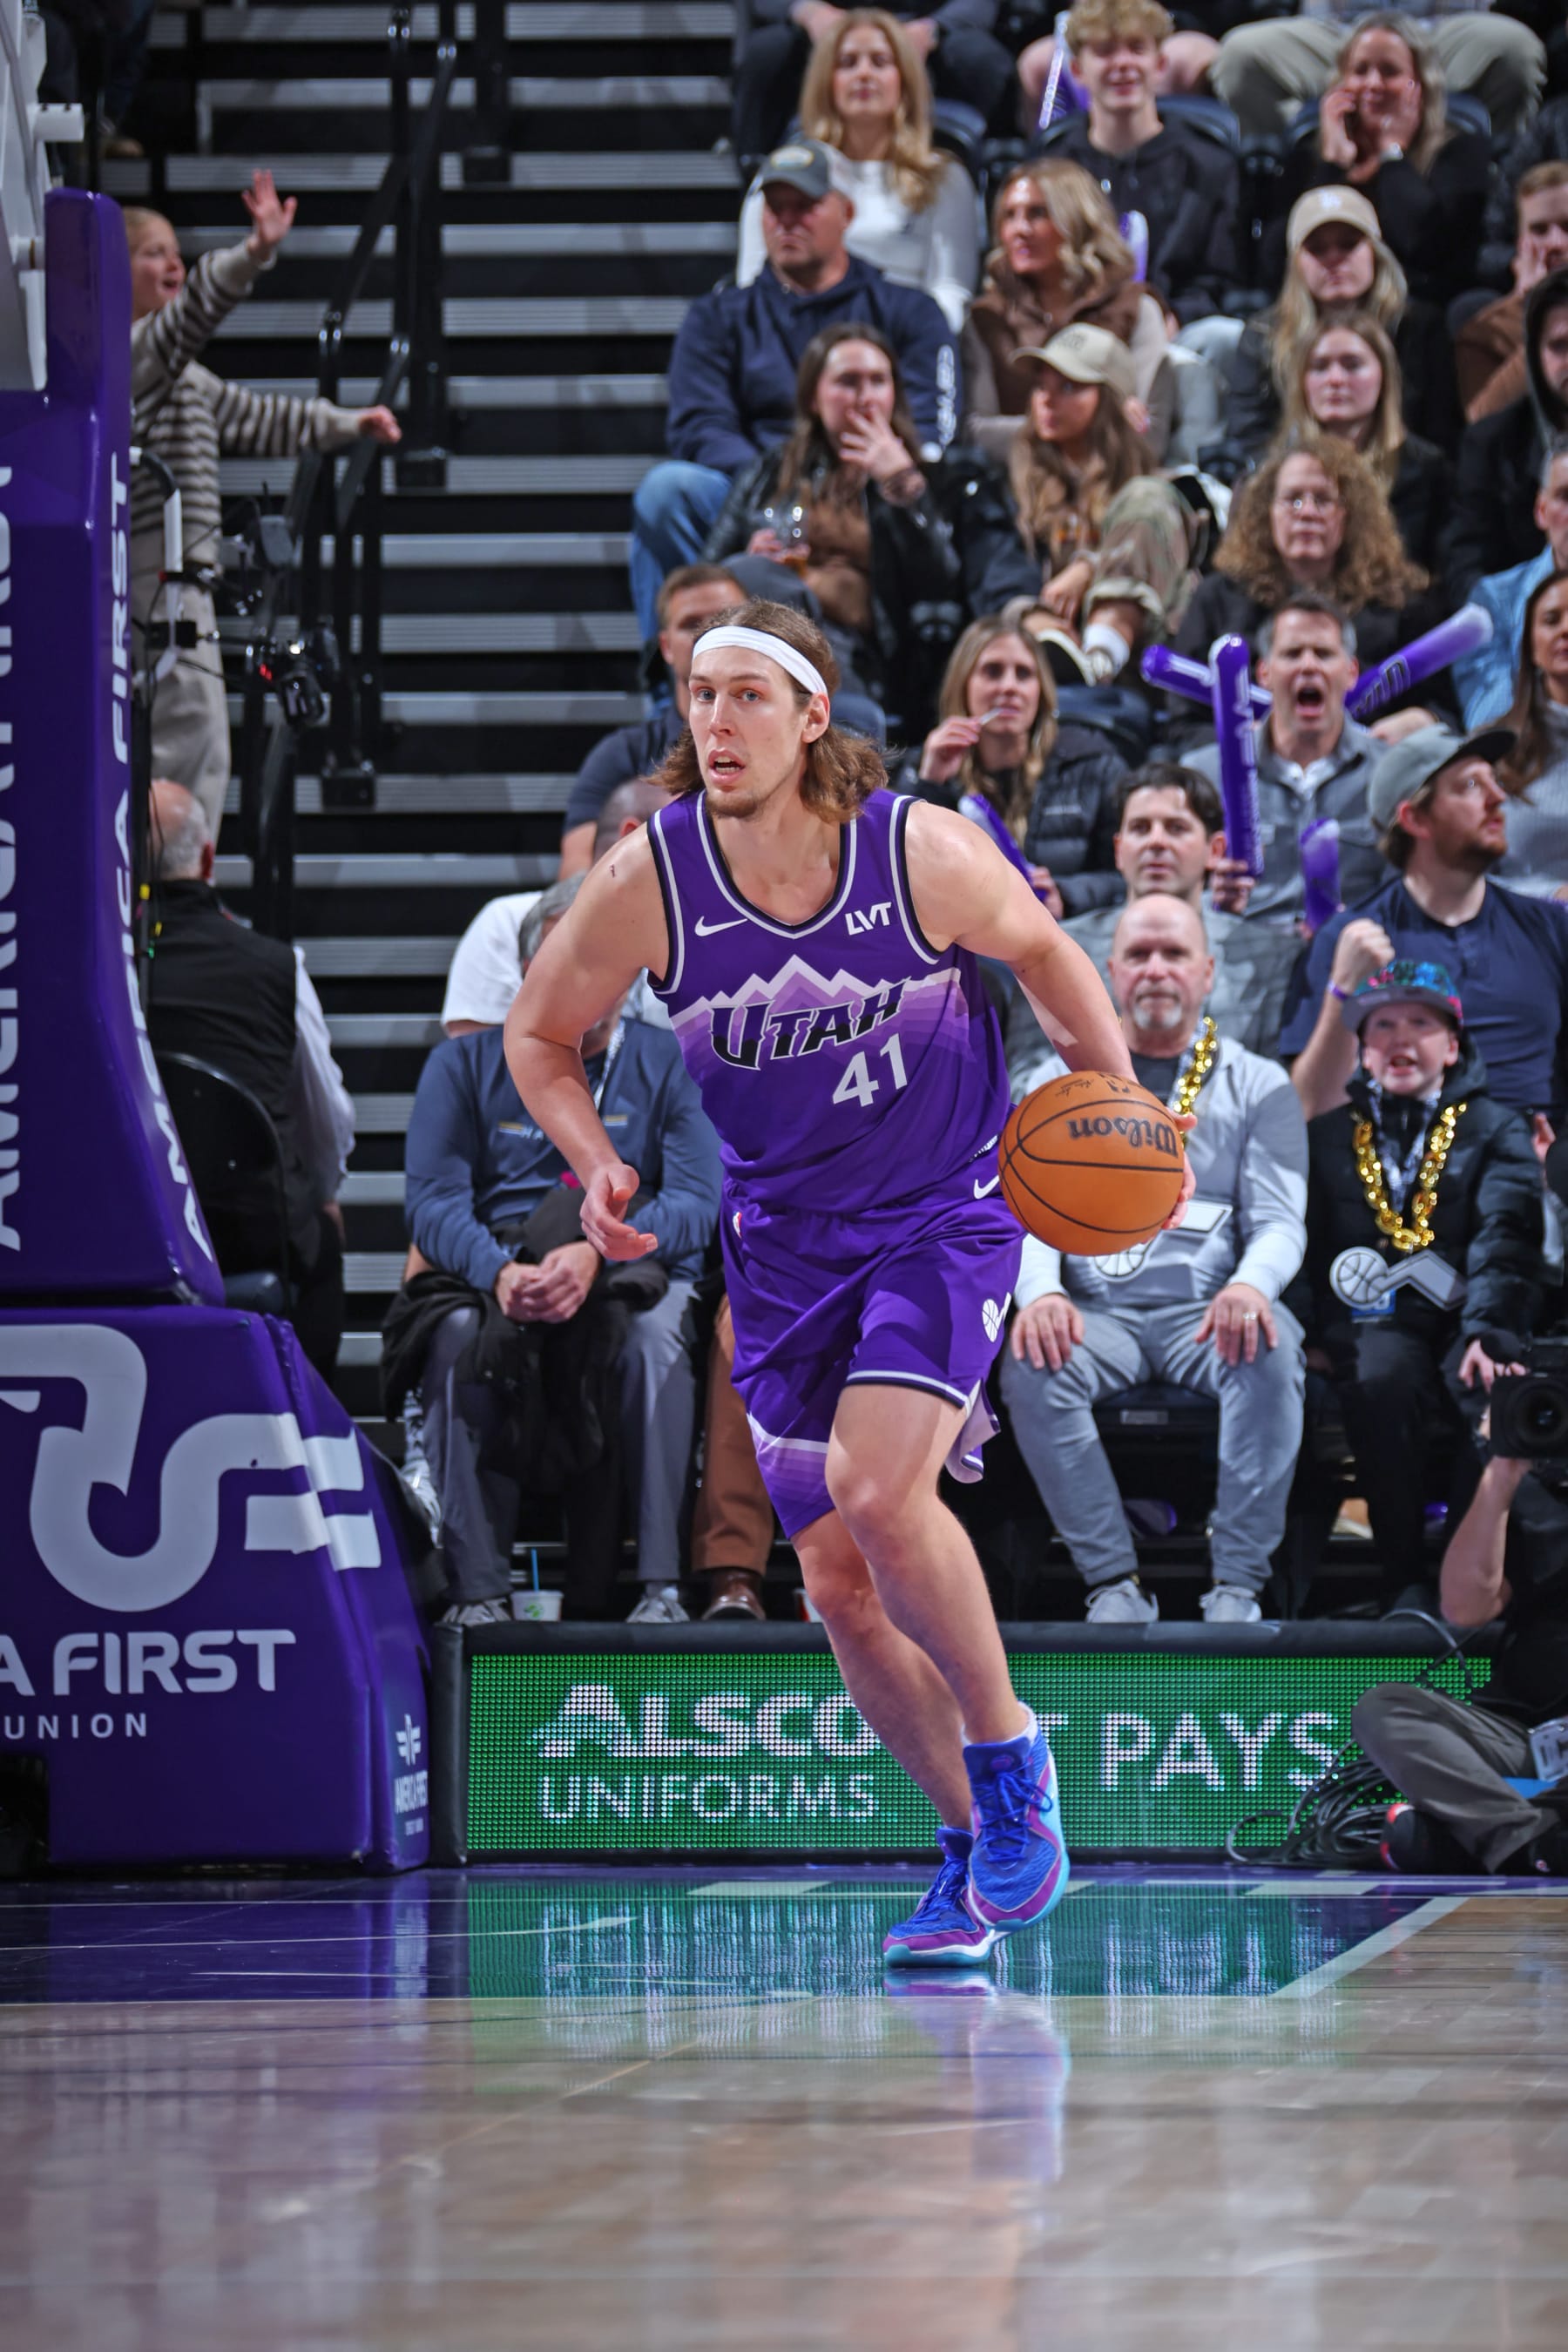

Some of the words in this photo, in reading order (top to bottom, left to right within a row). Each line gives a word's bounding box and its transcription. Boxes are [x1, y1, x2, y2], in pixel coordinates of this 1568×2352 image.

[111, 451, 128, 765] FIRST
[845, 902, 892, 936] LVT
[708, 976, 911, 1071] UTAH
[832, 1032, 908, 1107] 41
[1065, 1116, 1179, 1159] Wilson
[53, 1629, 297, 1695] FIRST
[4, 1713, 146, 1740] UNION
[532, 1683, 882, 1758] ALSCO
[1100, 1712, 1340, 1791] PAYS
[537, 1774, 882, 1822] UNIFORMS
